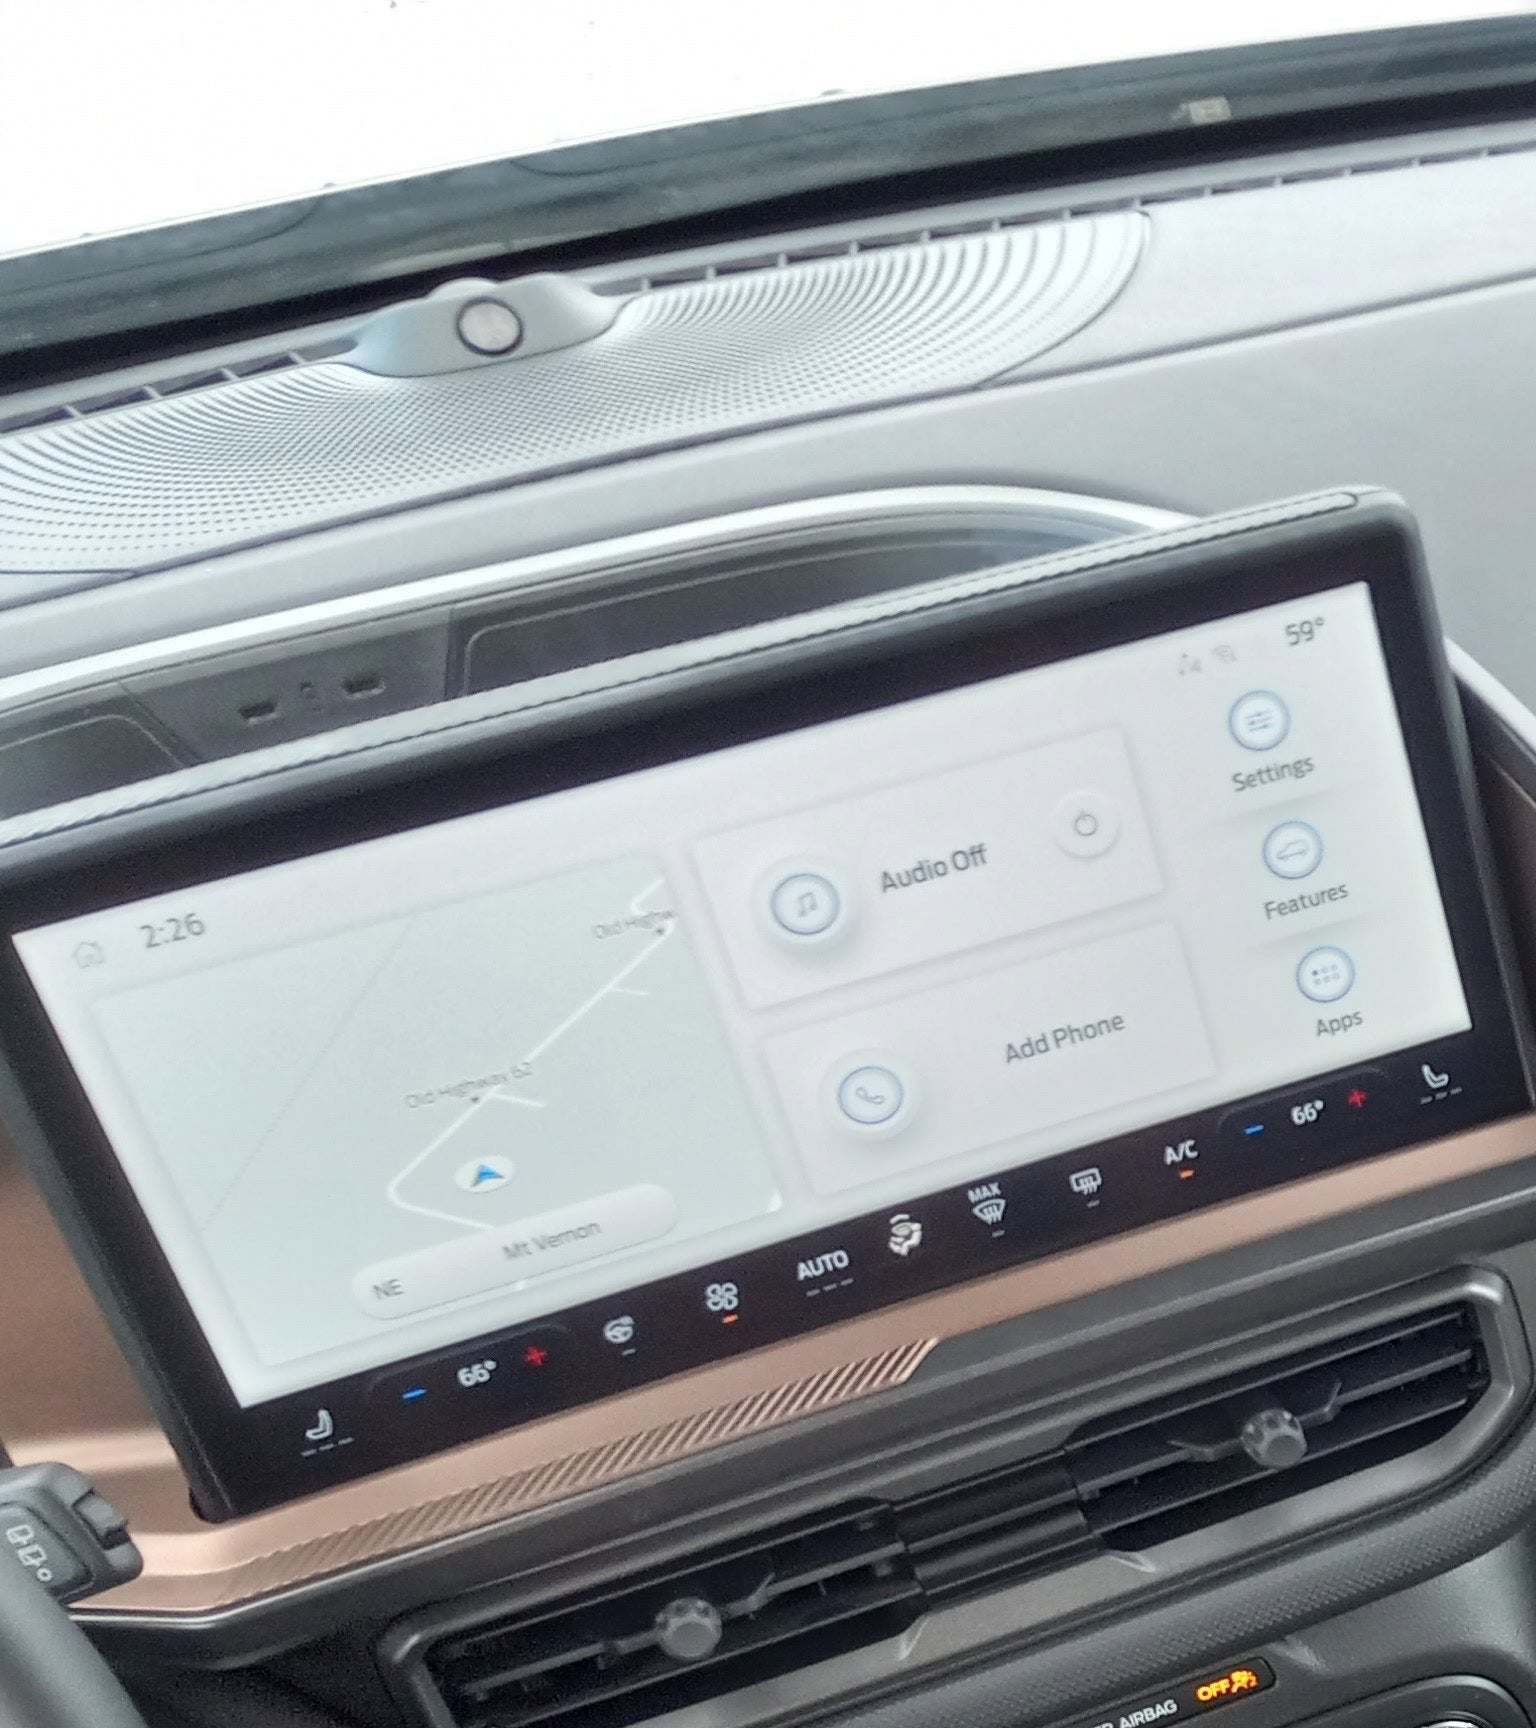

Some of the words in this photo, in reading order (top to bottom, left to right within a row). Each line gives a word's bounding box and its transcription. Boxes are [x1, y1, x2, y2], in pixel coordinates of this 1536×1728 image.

[1285, 616, 1325, 647] 59°
[1231, 754, 1315, 792] Settings
[879, 855, 949, 894] Audio
[951, 842, 988, 876] Off
[1264, 881, 1349, 920] Features
[142, 911, 206, 950] 2:26
[1004, 1028, 1051, 1065] Add
[1053, 1009, 1126, 1051] Phone
[1315, 1009, 1363, 1038] Apps
[1290, 1099, 1325, 1126] 66°
[1164, 1139, 1199, 1166] A/C
[967, 1182, 1001, 1202] MAX
[373, 1278, 404, 1300] NE
[532, 1222, 602, 1251] Vernon
[797, 1250, 849, 1280] AUTO
[1196, 1679, 1231, 1702] OFF
